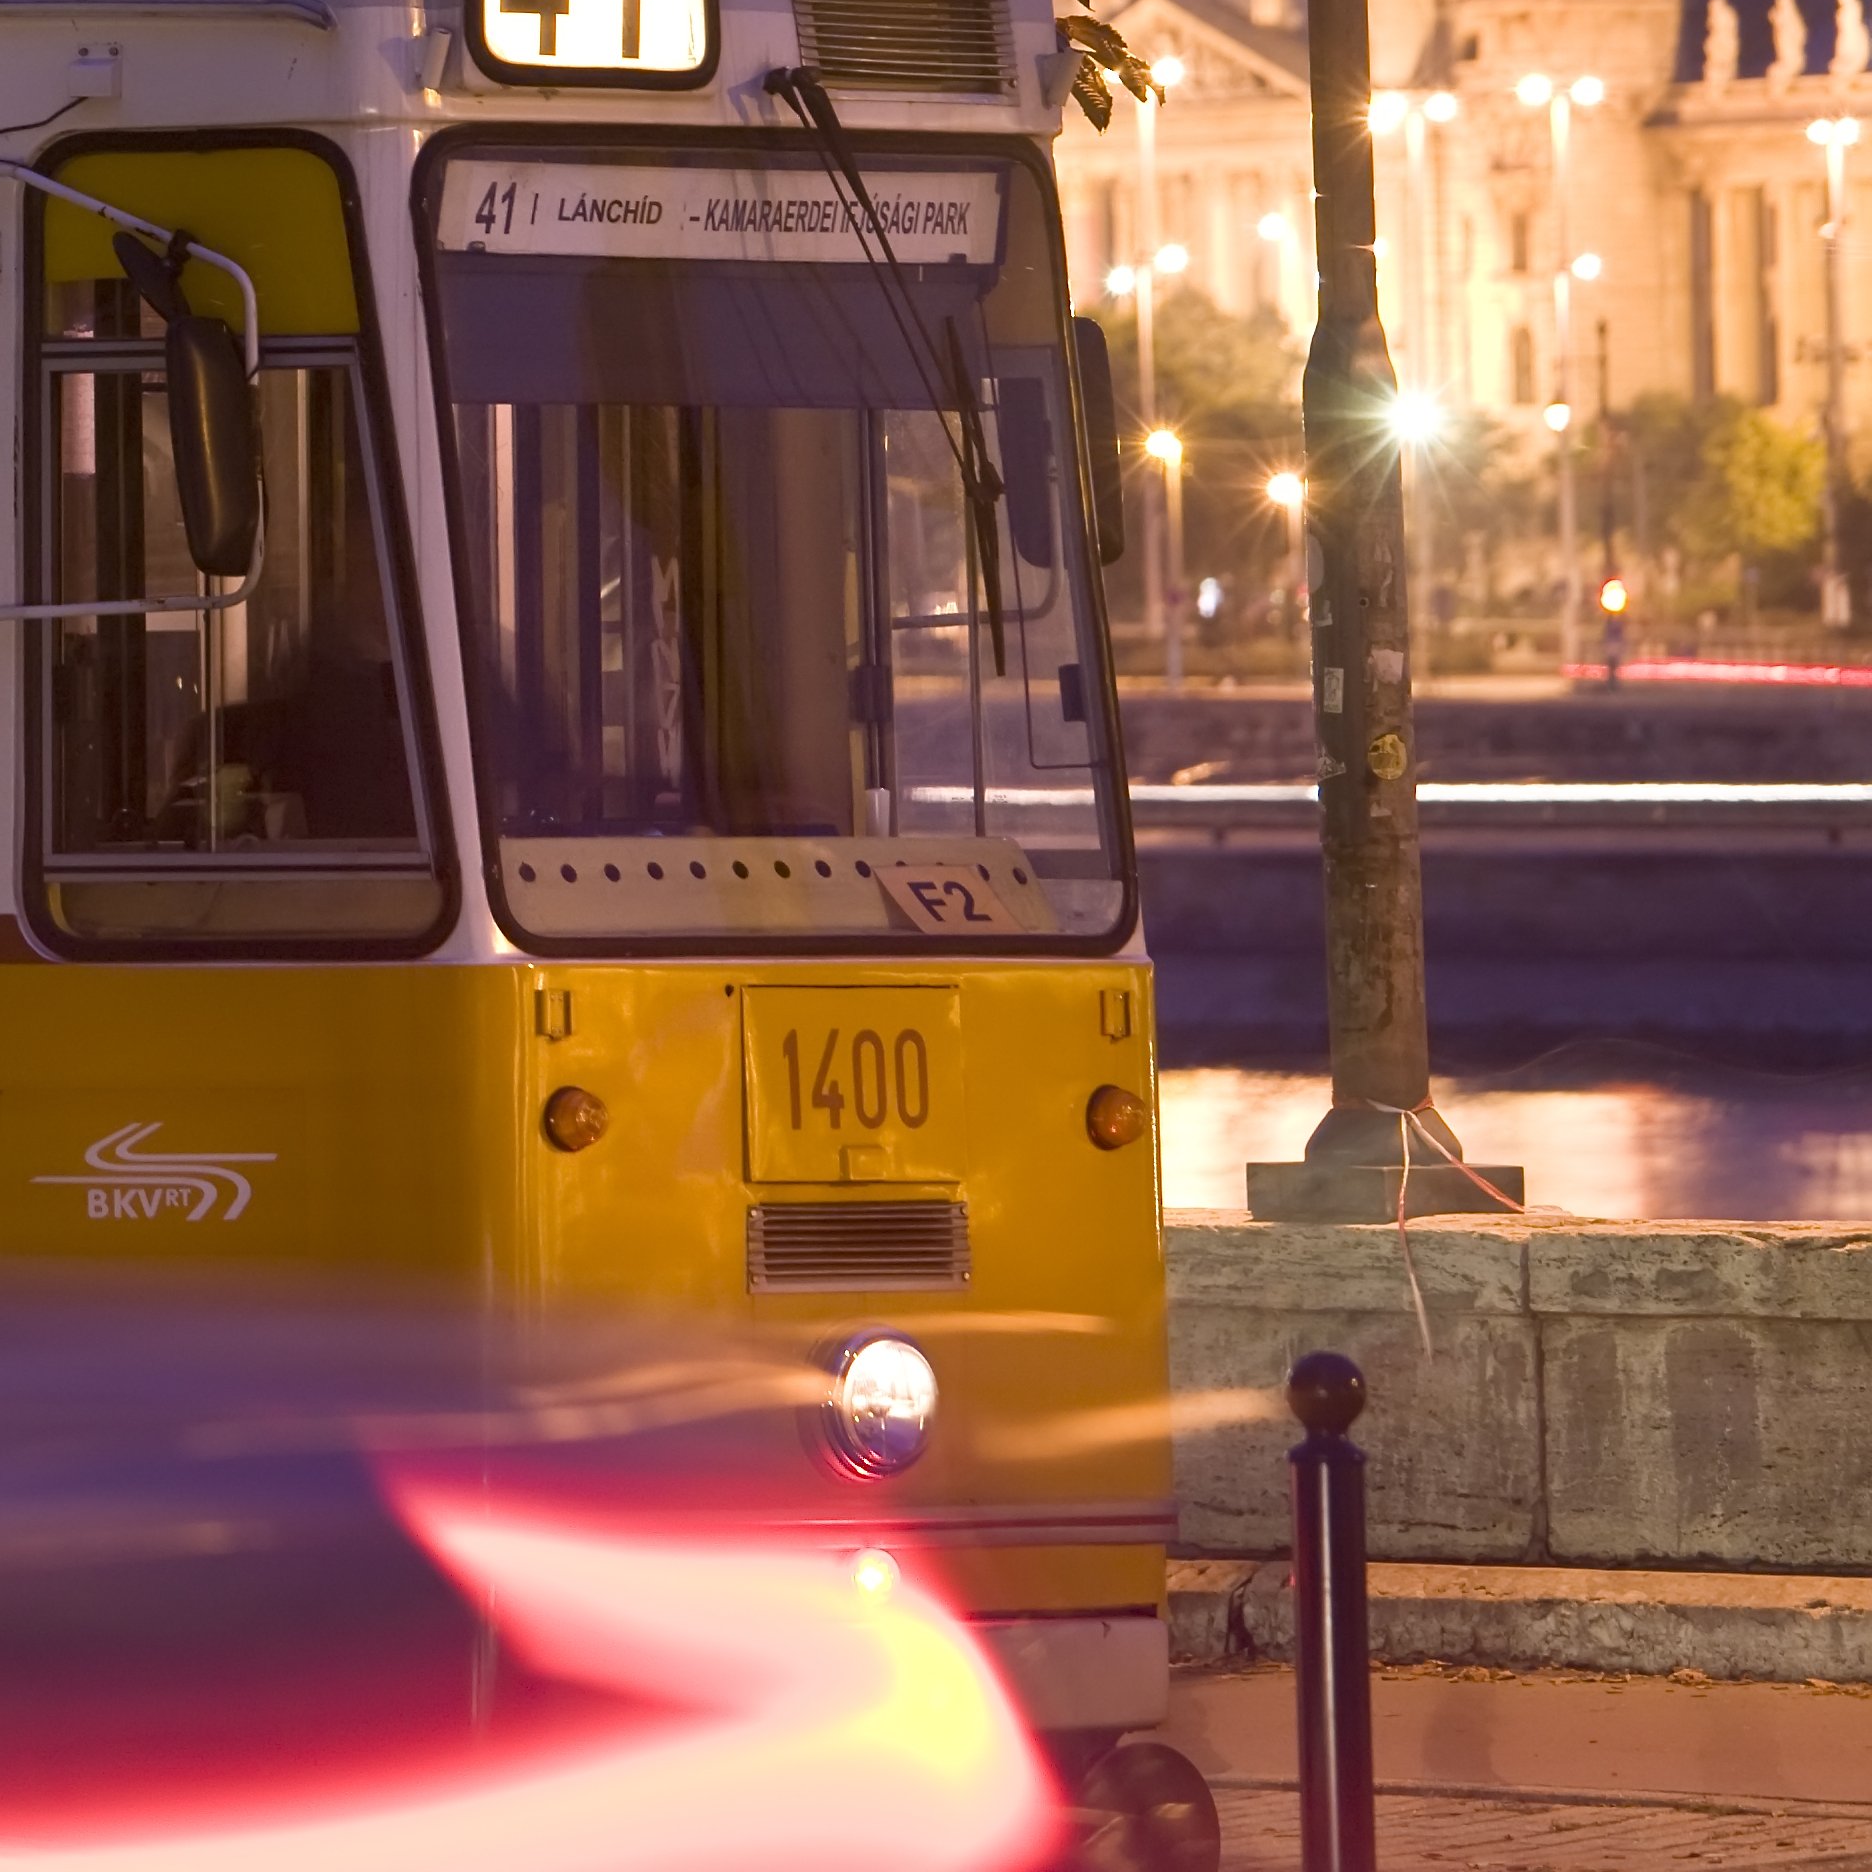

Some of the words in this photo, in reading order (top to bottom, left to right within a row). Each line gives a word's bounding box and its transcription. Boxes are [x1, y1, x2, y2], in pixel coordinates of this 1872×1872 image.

[475, 180, 518, 235] 41
[557, 191, 664, 225] LÁNCHÍD
[703, 197, 839, 233] KAMARAERDEI
[922, 201, 971, 235] PARK
[906, 880, 993, 923] F2
[782, 1027, 929, 1131] 1400
